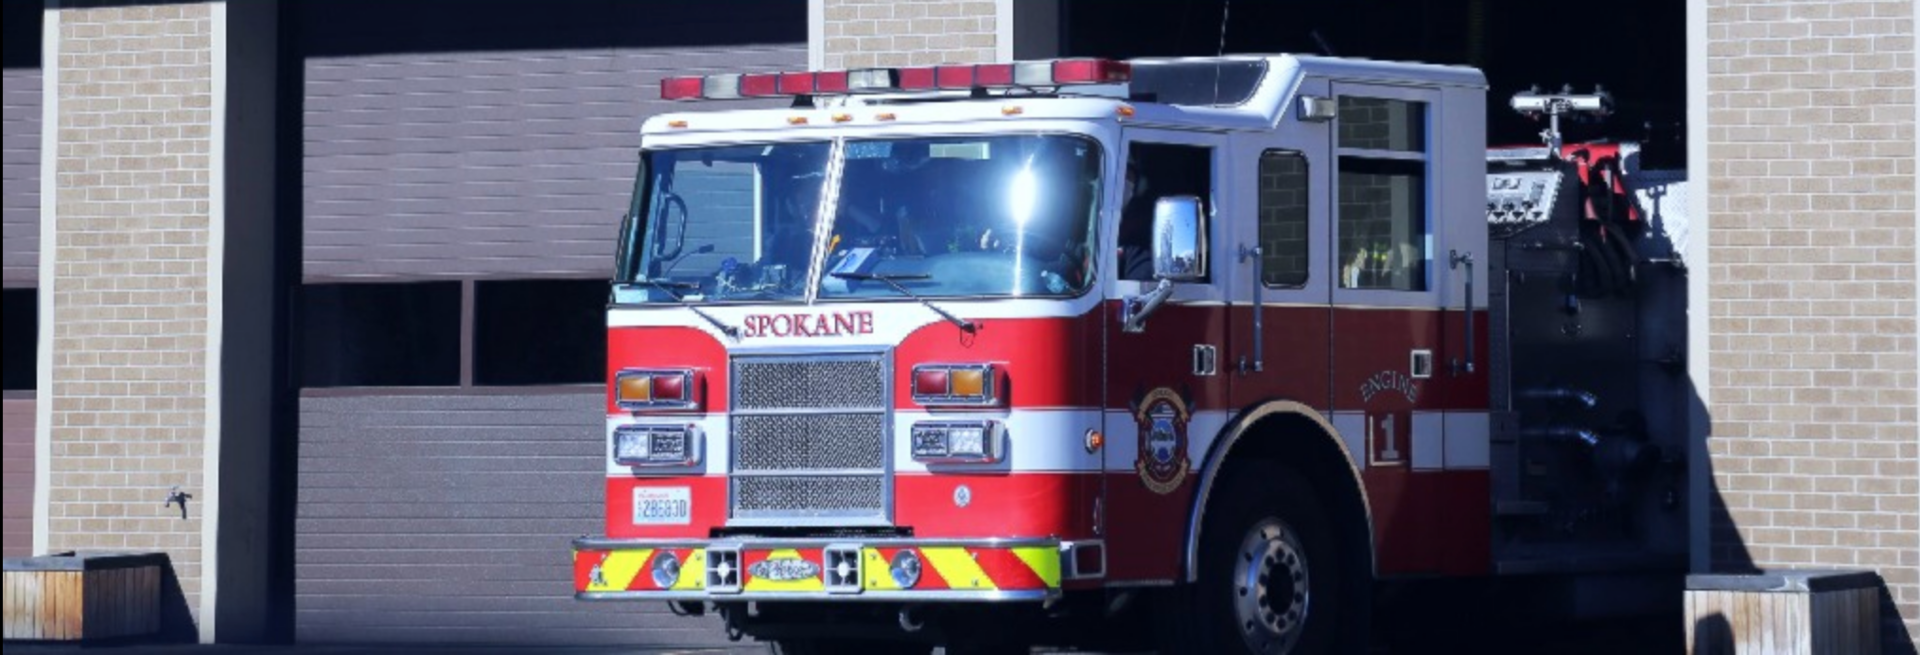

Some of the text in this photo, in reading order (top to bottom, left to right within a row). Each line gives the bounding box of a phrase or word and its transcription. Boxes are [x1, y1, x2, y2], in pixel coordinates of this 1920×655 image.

[743, 310, 874, 338] SPOKANE
[1360, 370, 1418, 403] ENGINE
[1381, 413, 1399, 459] 1
